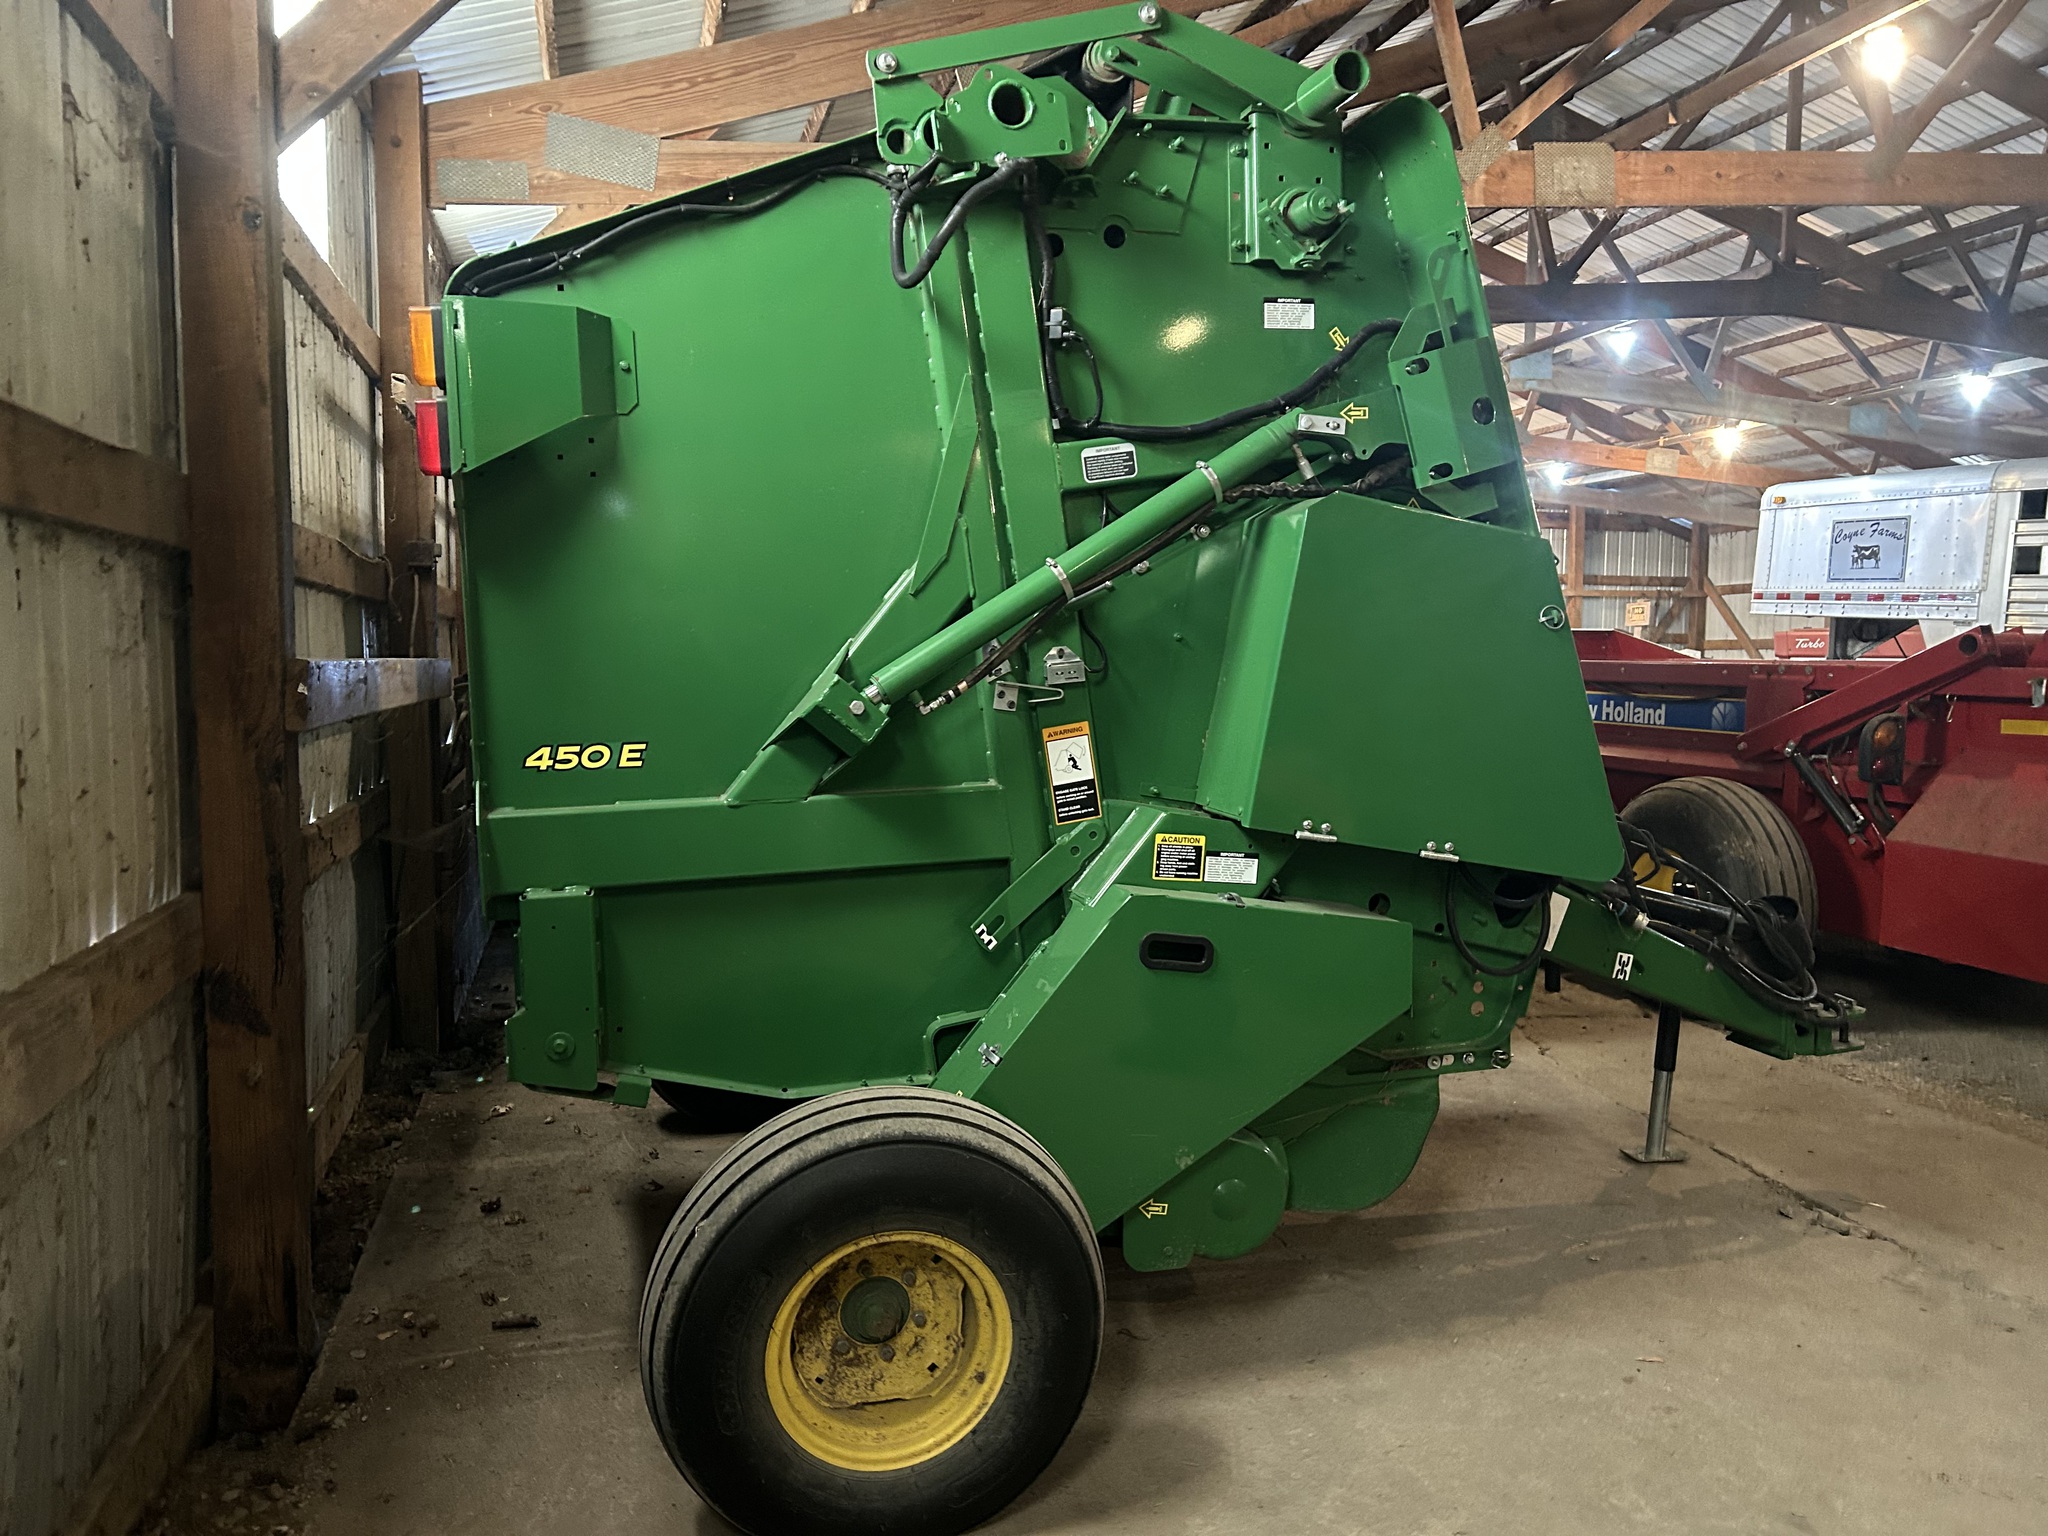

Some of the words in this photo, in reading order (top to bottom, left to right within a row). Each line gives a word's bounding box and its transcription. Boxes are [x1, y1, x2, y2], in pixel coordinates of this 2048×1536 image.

[1834, 528, 1866, 544] Coyne
[1869, 522, 1906, 541] Farms
[1795, 637, 1826, 649] Turbo
[1601, 699, 1666, 726] Holland
[1053, 726, 1084, 737] WARNING
[523, 743, 612, 771] 450
[617, 742, 648, 769] E
[1167, 836, 1201, 844] CAUTION
